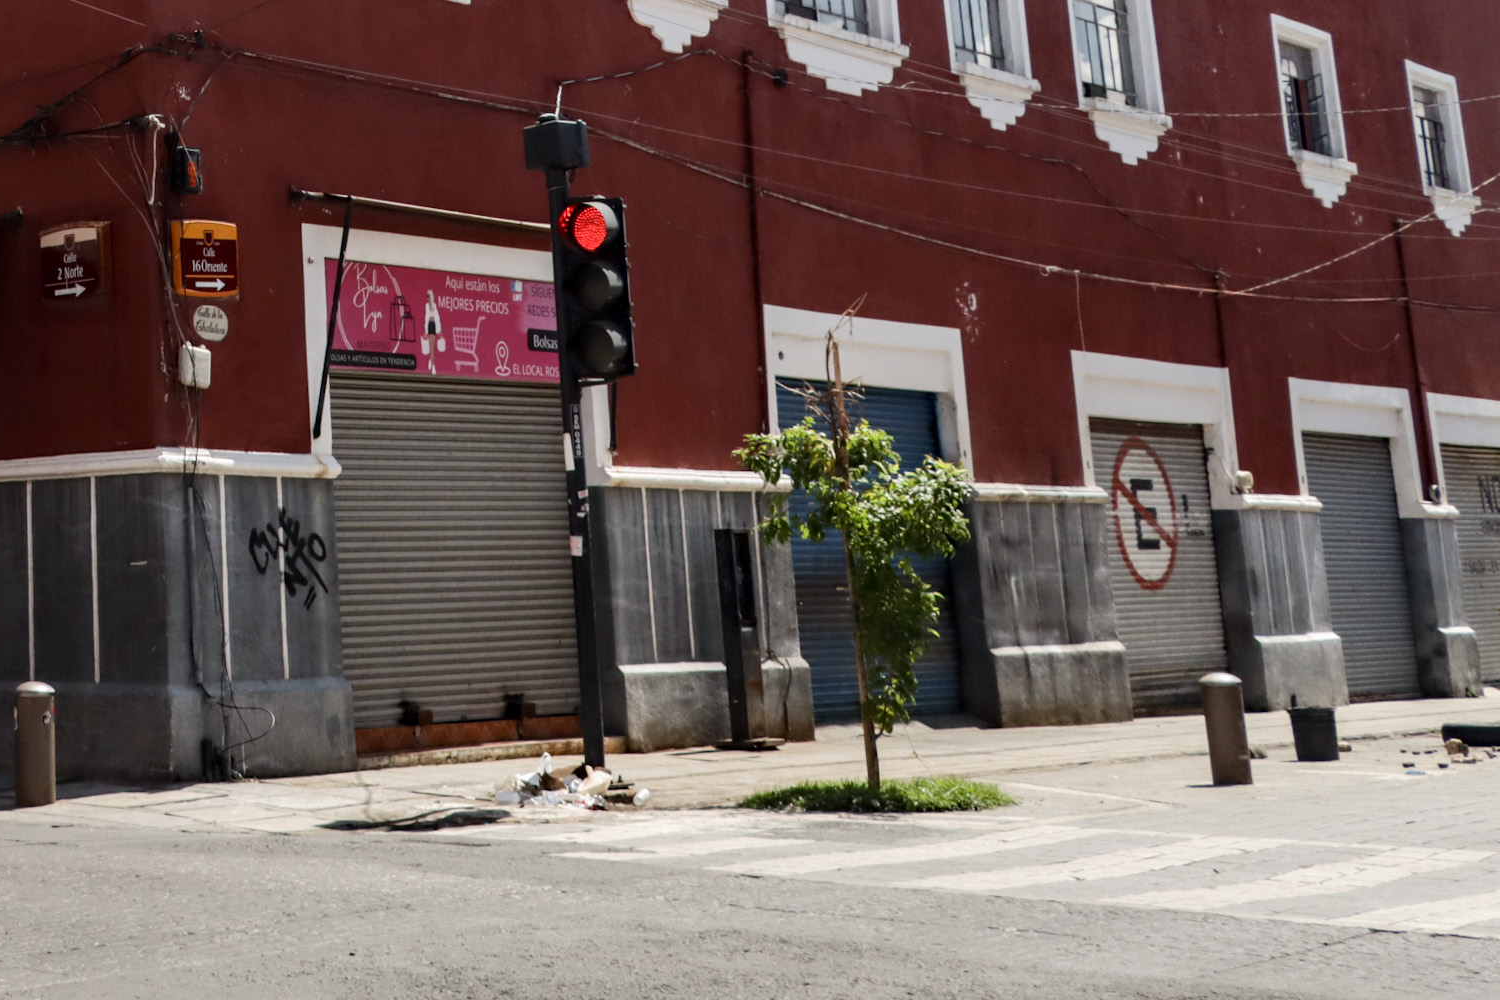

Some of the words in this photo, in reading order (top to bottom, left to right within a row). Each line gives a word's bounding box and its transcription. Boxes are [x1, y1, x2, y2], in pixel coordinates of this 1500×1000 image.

[63, 252, 77, 263] Calle
[203, 247, 216, 257] Calle
[57, 267, 62, 280] 2
[65, 265, 83, 279] Norte
[192, 260, 201, 272] 16
[201, 260, 228, 273] Oriente
[445, 275, 464, 292] Aquí
[465, 279, 487, 292] están
[488, 280, 500, 293] los
[438, 296, 474, 312] MEJORES
[475, 300, 509, 315] PRECIOS
[533, 334, 558, 350] Bolsas
[330, 353, 347, 362] OLSAS
[513, 363, 521, 375] EL
[522, 364, 544, 377] LOCAL
[1130, 479, 1160, 549] E
